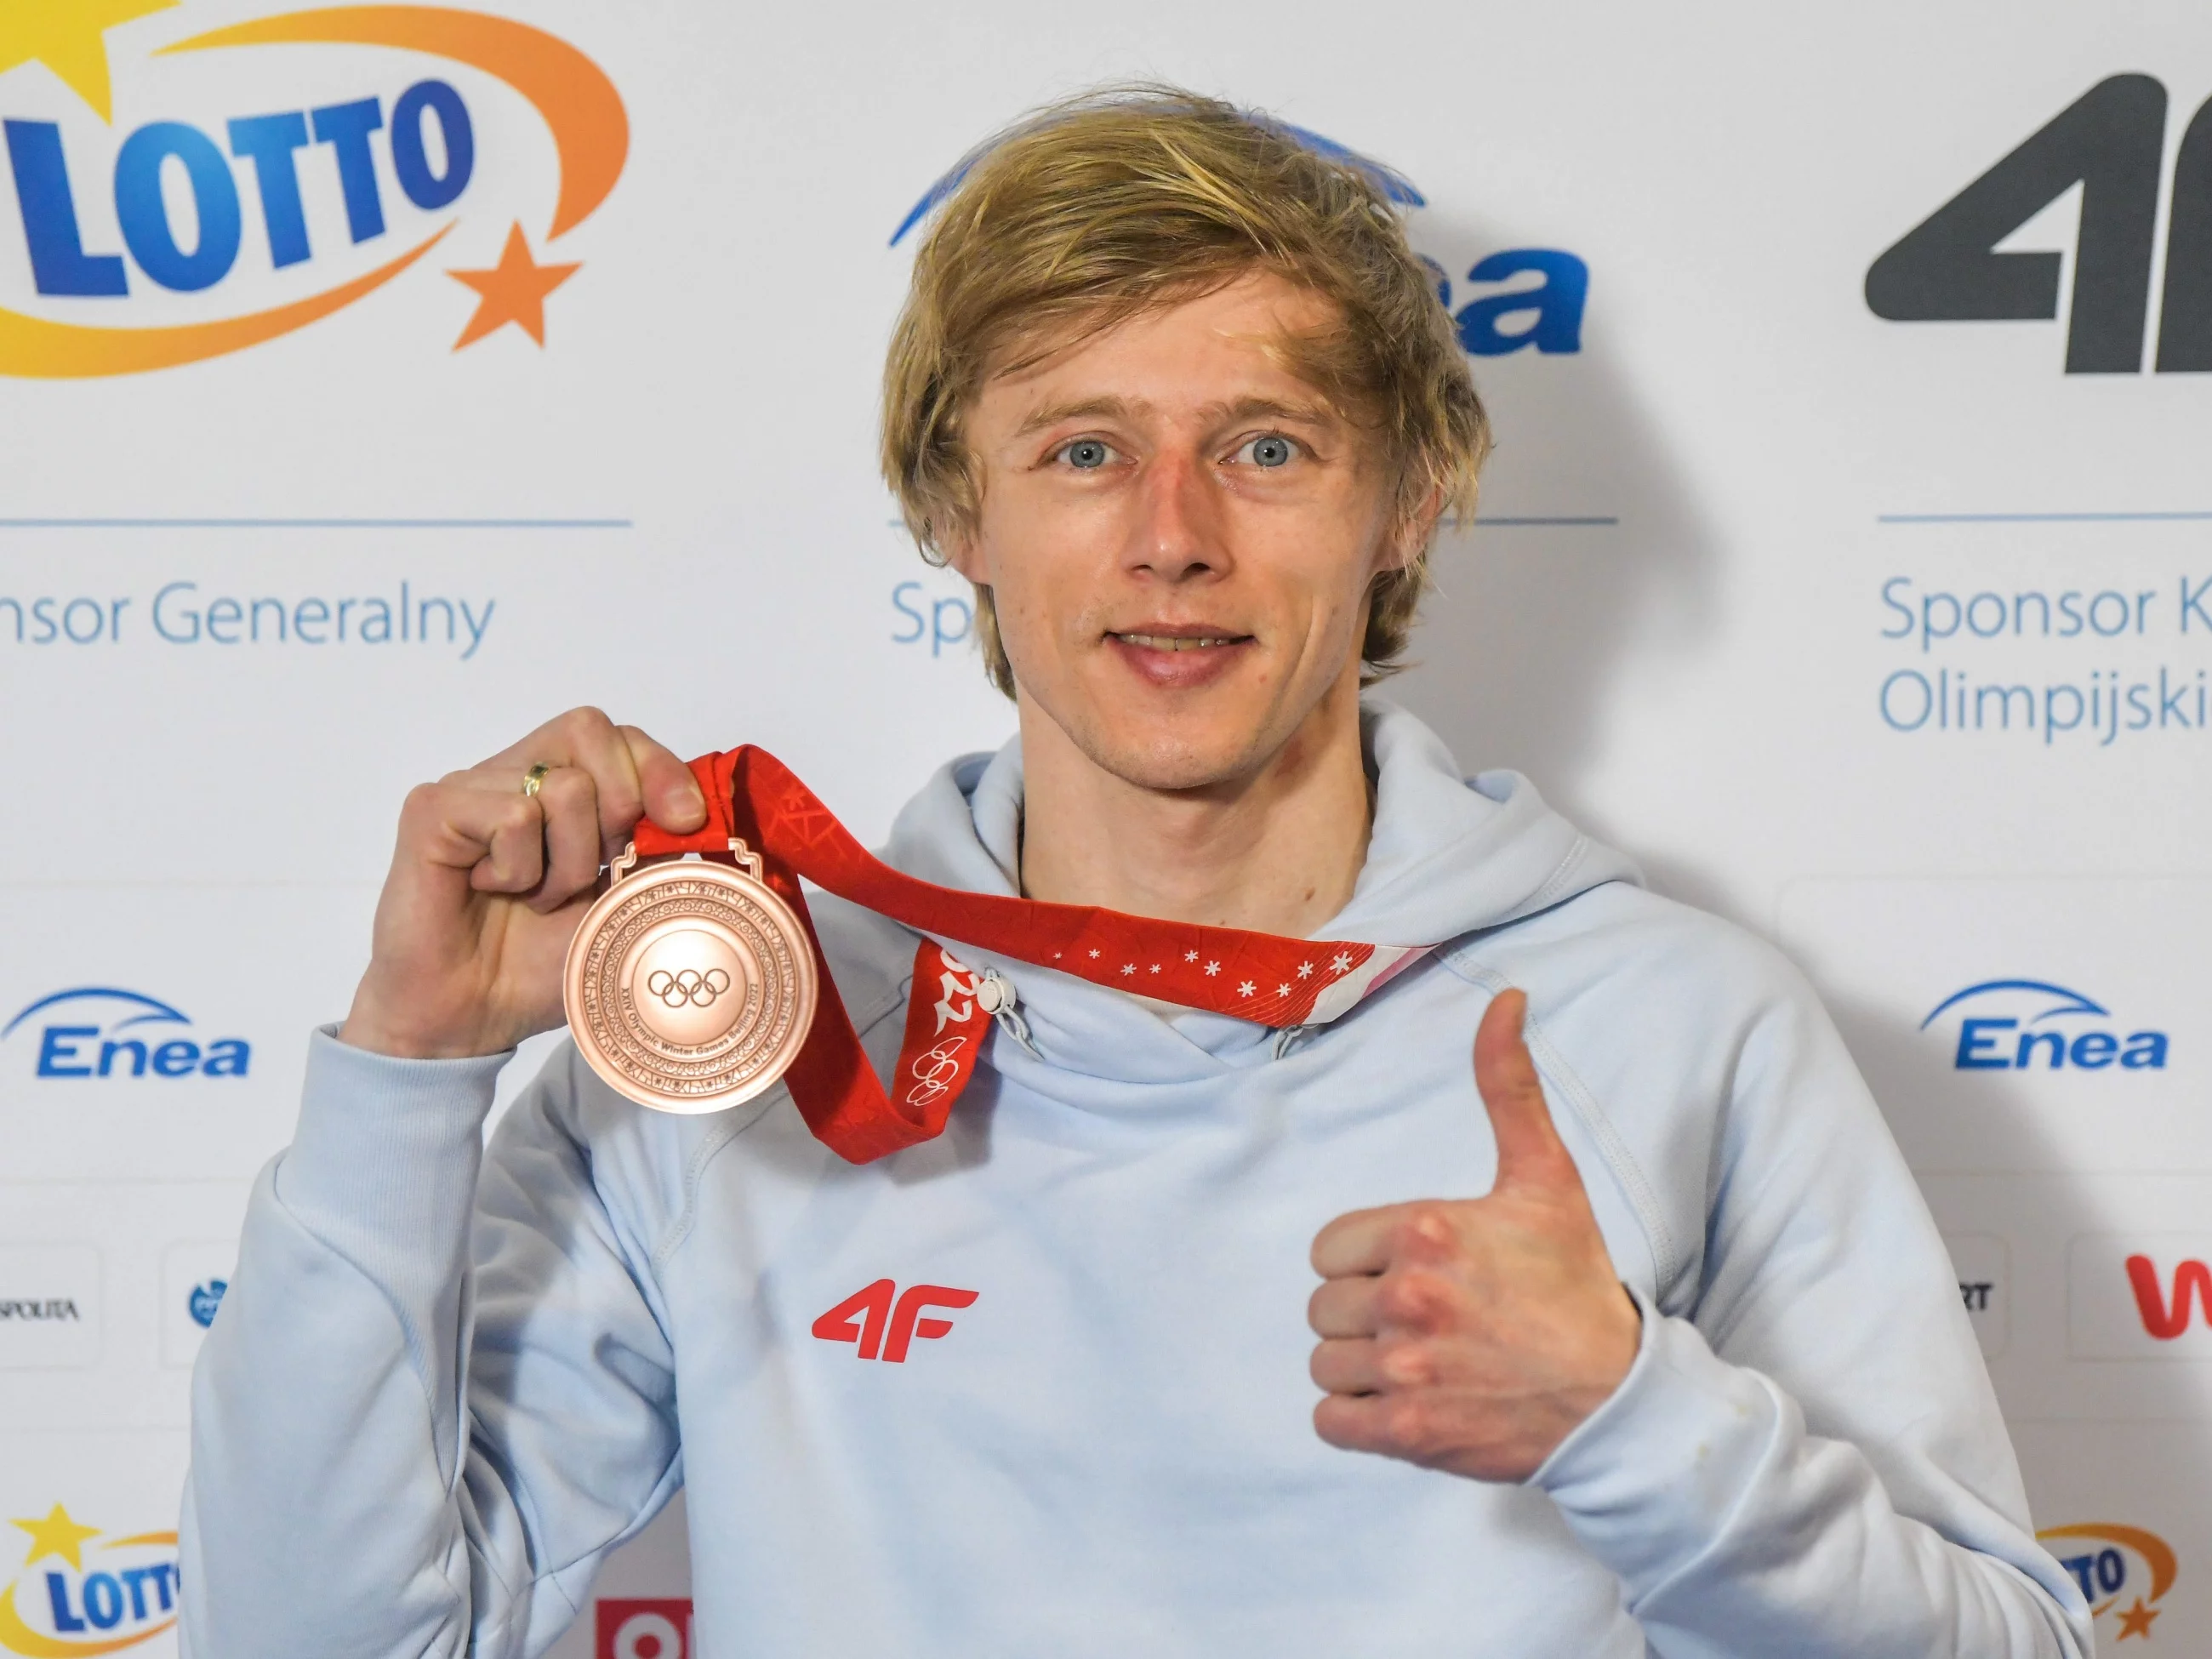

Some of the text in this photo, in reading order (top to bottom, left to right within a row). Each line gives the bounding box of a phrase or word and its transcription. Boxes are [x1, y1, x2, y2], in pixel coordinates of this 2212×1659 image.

[2, 78, 475, 299] LOTTO
[151, 579, 496, 662] Generalny
[891, 581, 972, 658] Sp
[1880, 575, 2212, 653] Sponsor K
[1879, 665, 2209, 747] Olimpijski
[35, 1027, 251, 1079] Enea
[621, 983, 759, 1056] XXIV Olympic Winter Games Beijing 2022
[1954, 1018, 2169, 1070] Enea
[812, 1279, 979, 1363] 4F
[45, 1561, 180, 1632] LOTT
[2060, 1548, 2126, 1604] TO
